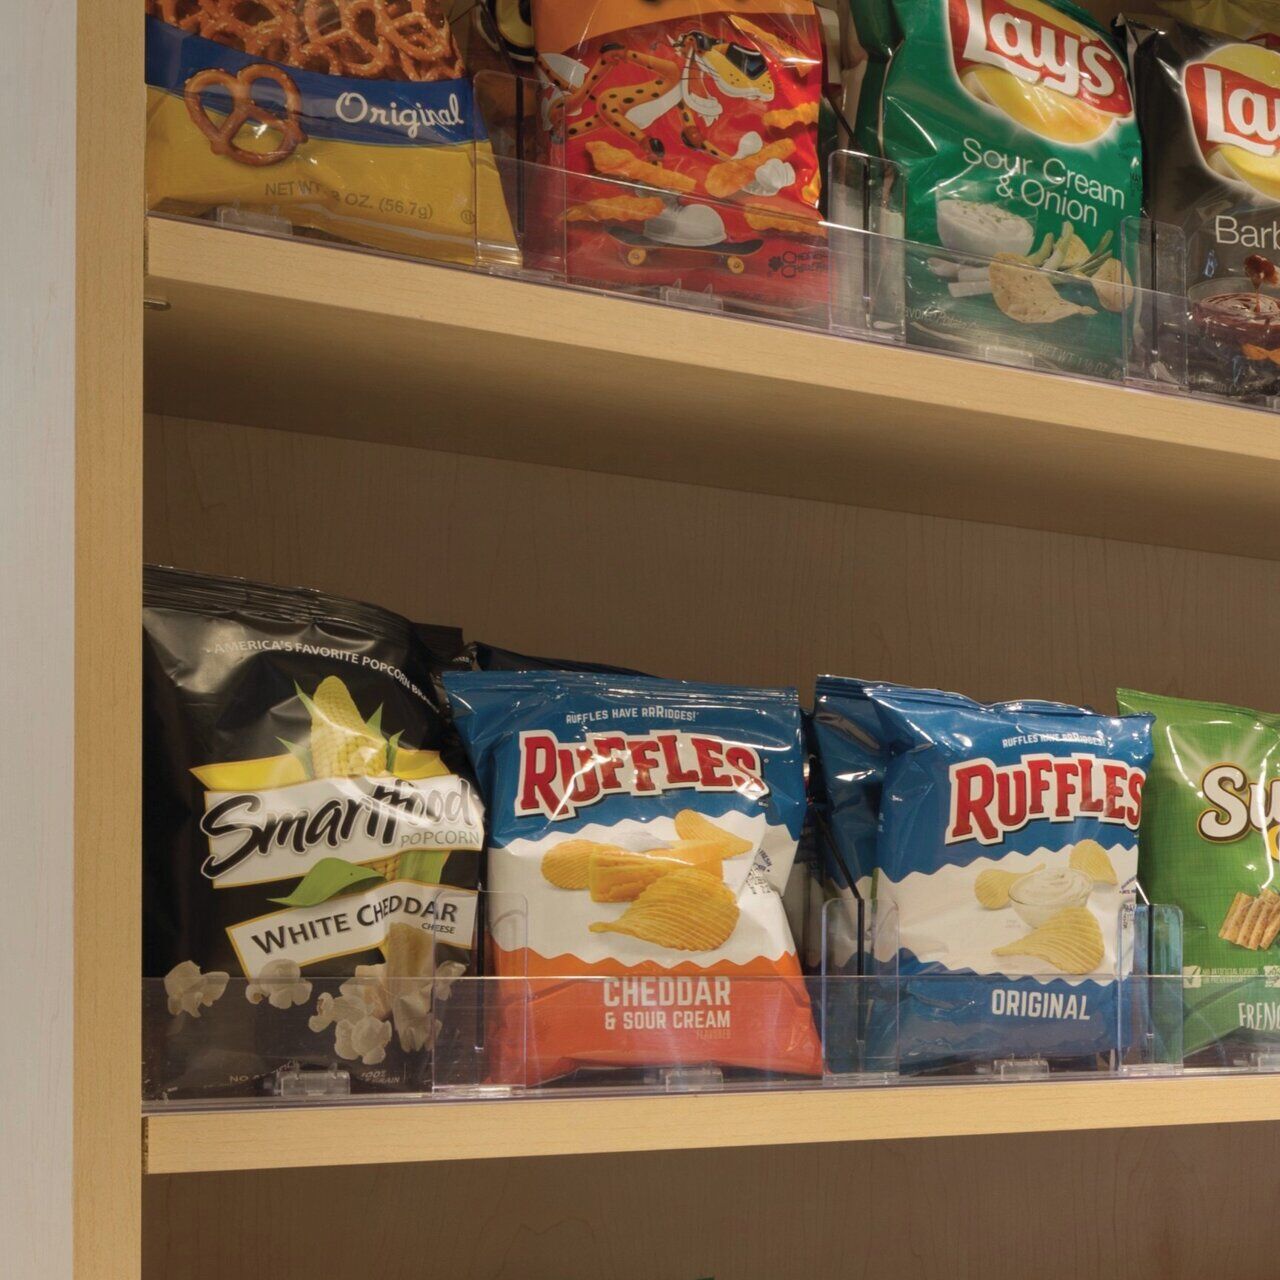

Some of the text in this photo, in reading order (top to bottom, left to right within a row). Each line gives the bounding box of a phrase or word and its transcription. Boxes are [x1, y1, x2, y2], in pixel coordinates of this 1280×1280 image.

[963, 0, 1116, 97] Lay's
[336, 92, 464, 137] Original
[962, 139, 1127, 210] Sour Cream
[1021, 179, 1099, 227] Onion
[516, 729, 770, 820] RUFFLES
[946, 752, 1145, 845] RUFFLES
[251, 894, 459, 955] WHITE CHEDDAR
[603, 975, 731, 1006] CHEDDAR
[992, 989, 1090, 1021] ORIGINAL
[624, 1009, 730, 1029] SOUR CREAM
